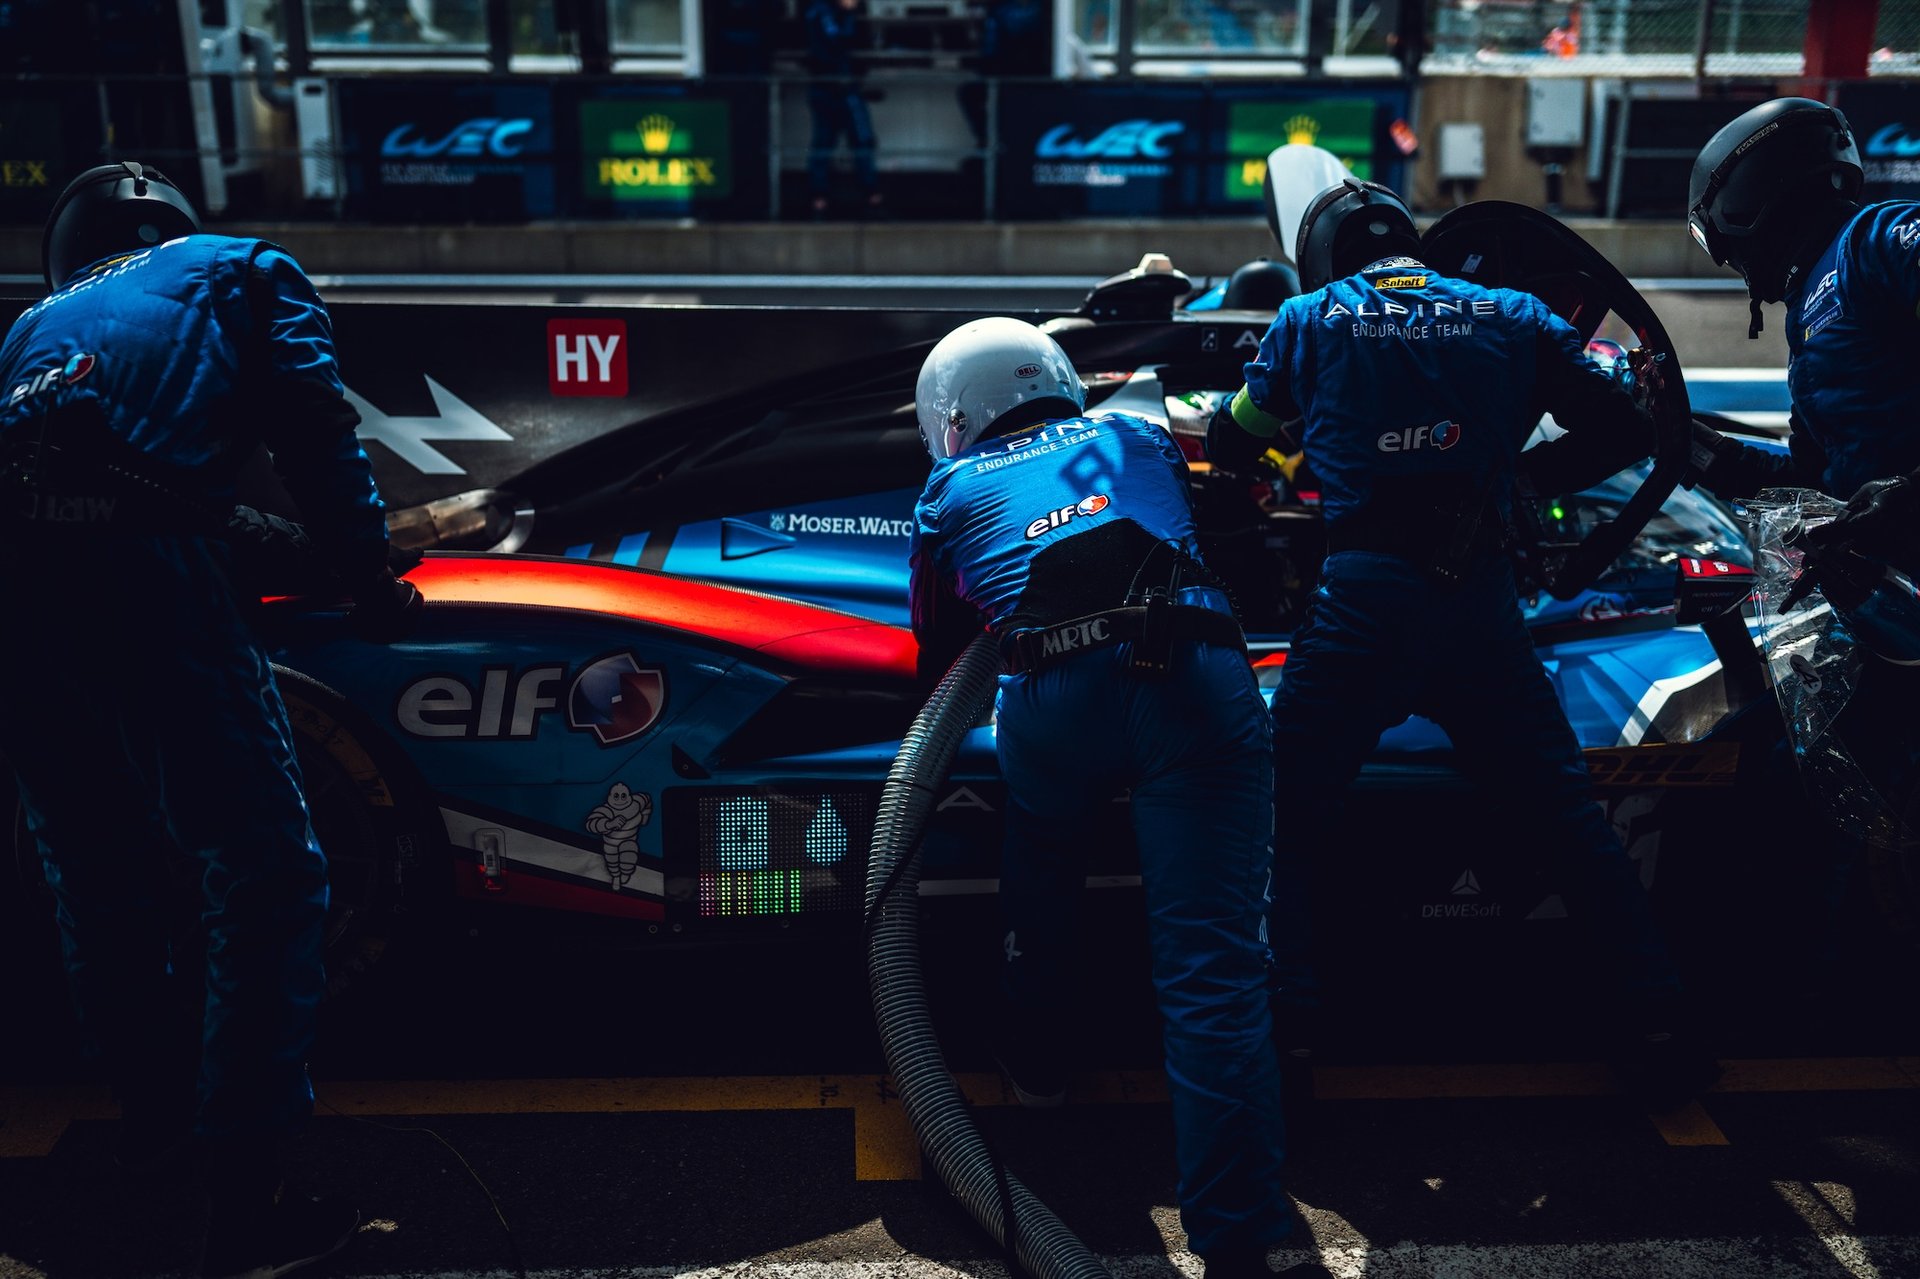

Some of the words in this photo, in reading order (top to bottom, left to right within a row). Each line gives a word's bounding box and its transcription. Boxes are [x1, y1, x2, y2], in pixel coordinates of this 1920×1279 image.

[2, 160, 47, 186] EX
[598, 157, 715, 186] ROLEX
[1324, 300, 1498, 319] ALPINE
[1352, 323, 1429, 340] ENDURANCE
[1436, 323, 1473, 337] TEAM
[555, 334, 621, 382] HY
[8, 367, 63, 408] elf
[976, 441, 1059, 473] ENDURANCE
[1063, 428, 1099, 447] TEAM
[1377, 426, 1429, 452] elf
[788, 513, 913, 537] MOSER.WATC
[1026, 505, 1075, 538] elf
[1042, 617, 1110, 658] MRTC
[397, 667, 563, 737] elf
[1421, 903, 1502, 918] DEWESoft
